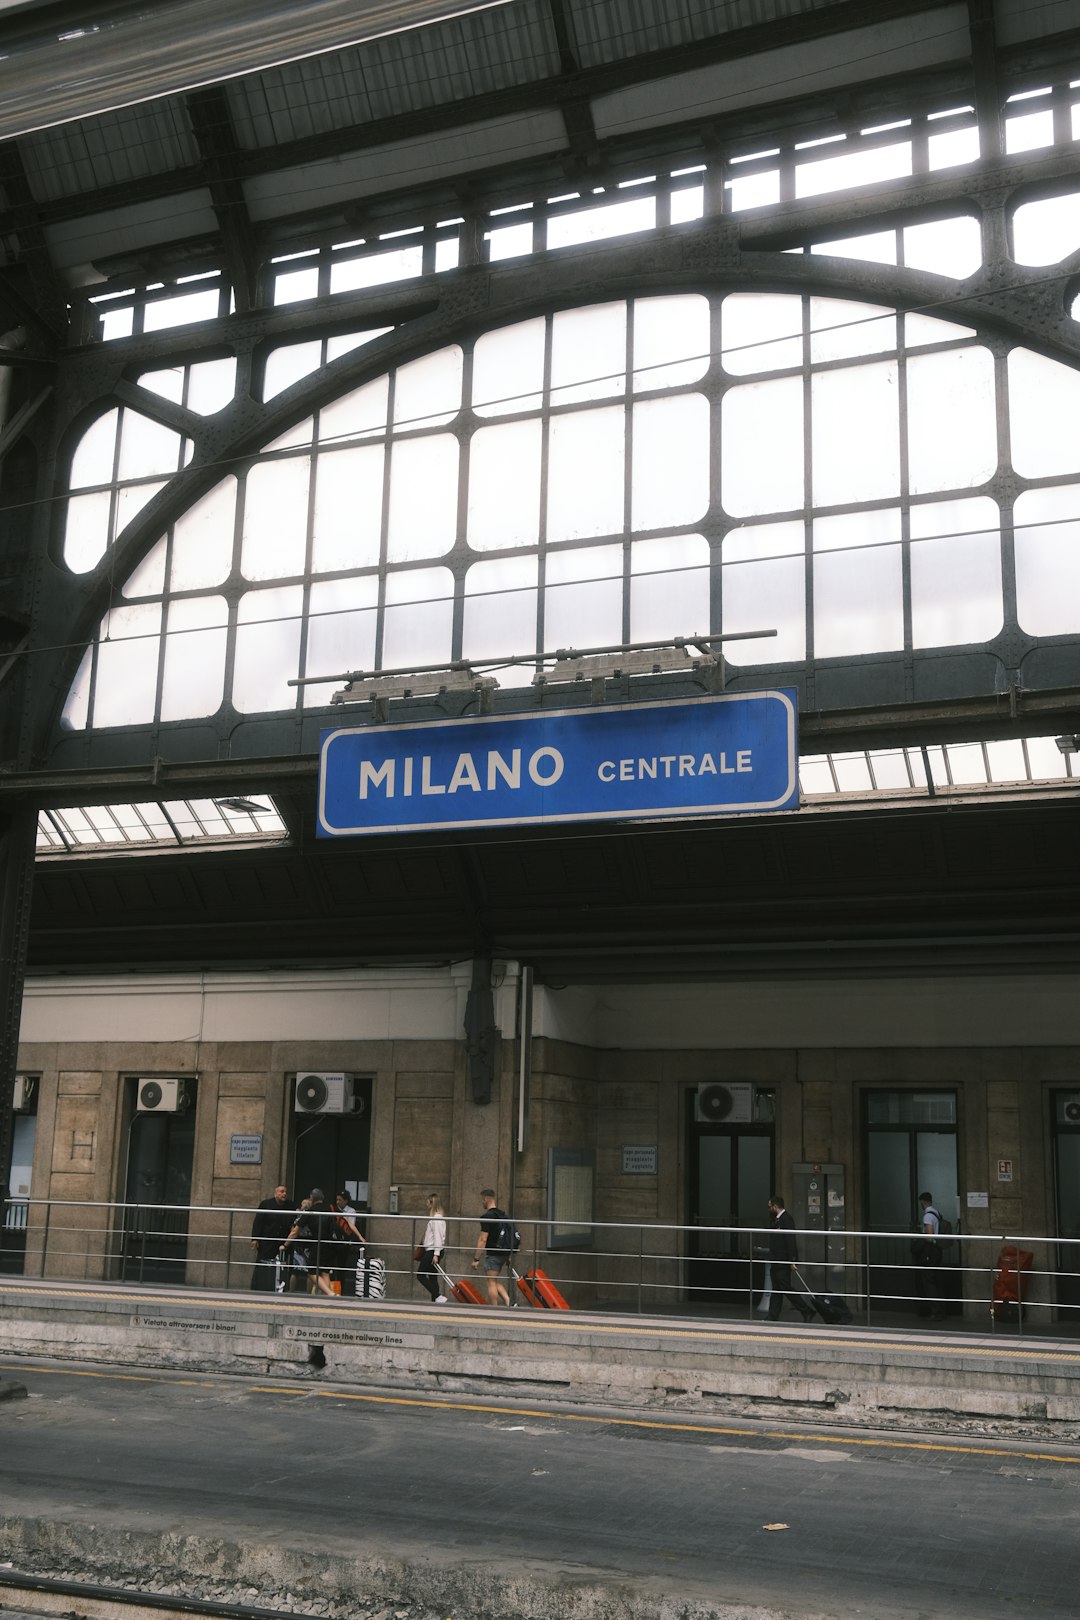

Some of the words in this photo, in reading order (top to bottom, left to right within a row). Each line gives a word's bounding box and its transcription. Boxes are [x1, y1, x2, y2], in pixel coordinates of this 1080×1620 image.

[359, 746, 564, 800] MILANO
[598, 749, 753, 783] CENTRALE
[143, 1318, 166, 1326] Vietato
[168, 1322, 210, 1330] attraversare
[297, 1329, 306, 1337] Do
[342, 1332, 354, 1340] the
[356, 1334, 384, 1344] railway
[385, 1336, 402, 1344] lines
